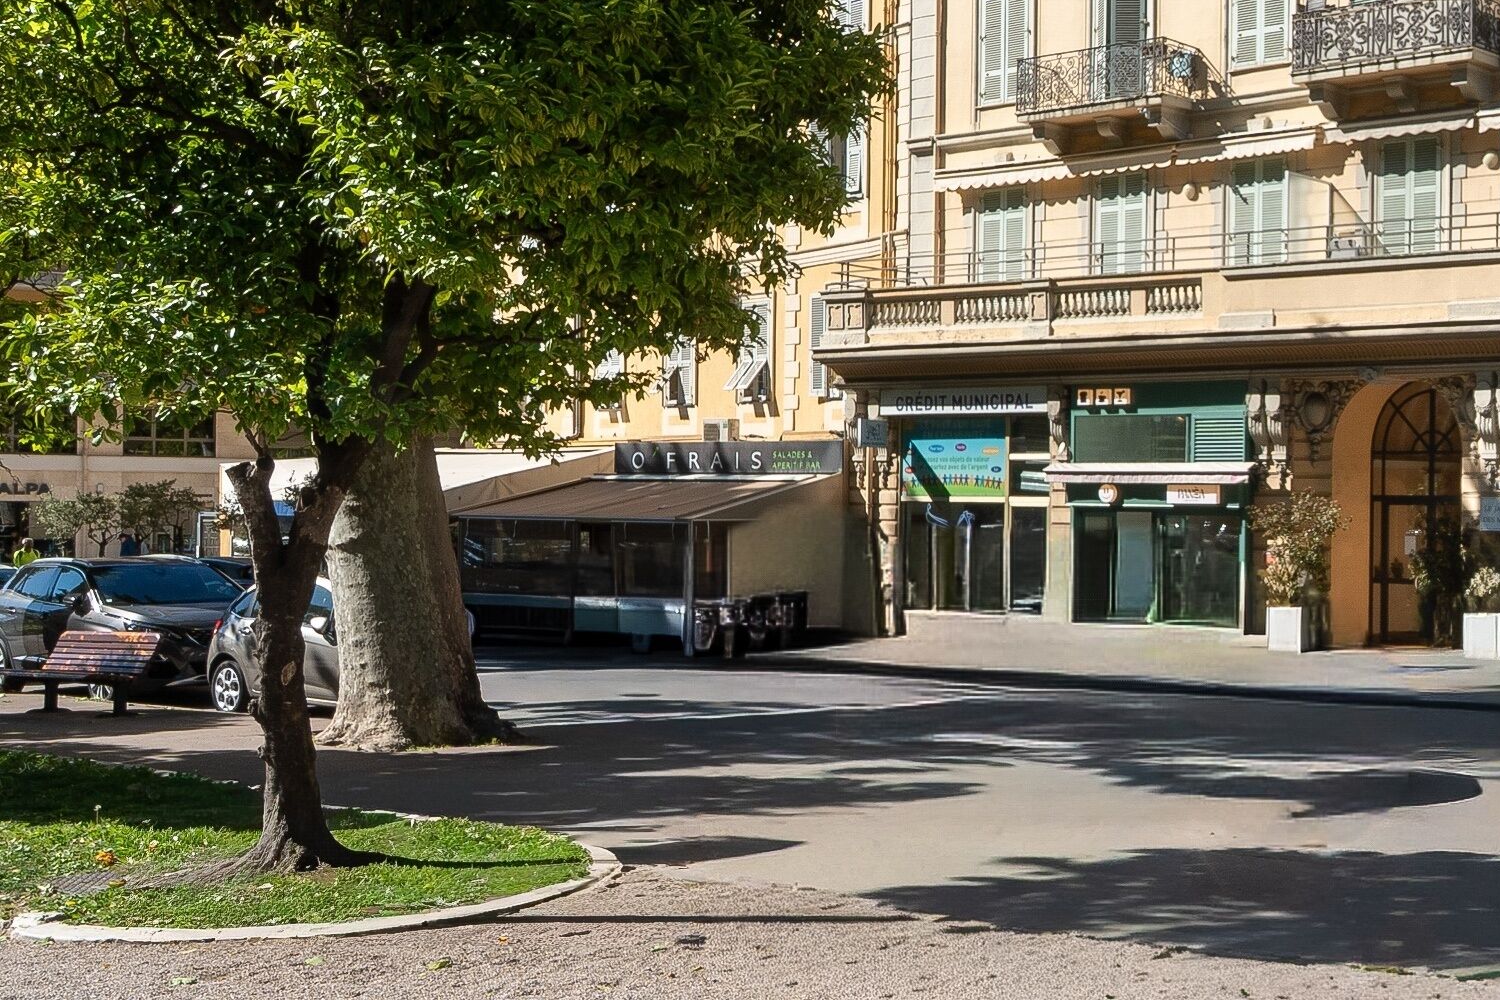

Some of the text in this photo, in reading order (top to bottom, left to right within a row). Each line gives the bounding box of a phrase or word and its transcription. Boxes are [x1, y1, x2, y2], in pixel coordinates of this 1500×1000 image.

[895, 391, 1034, 412] CRÉDIT MUNICIPAL
[772, 450, 806, 459] SALADES
